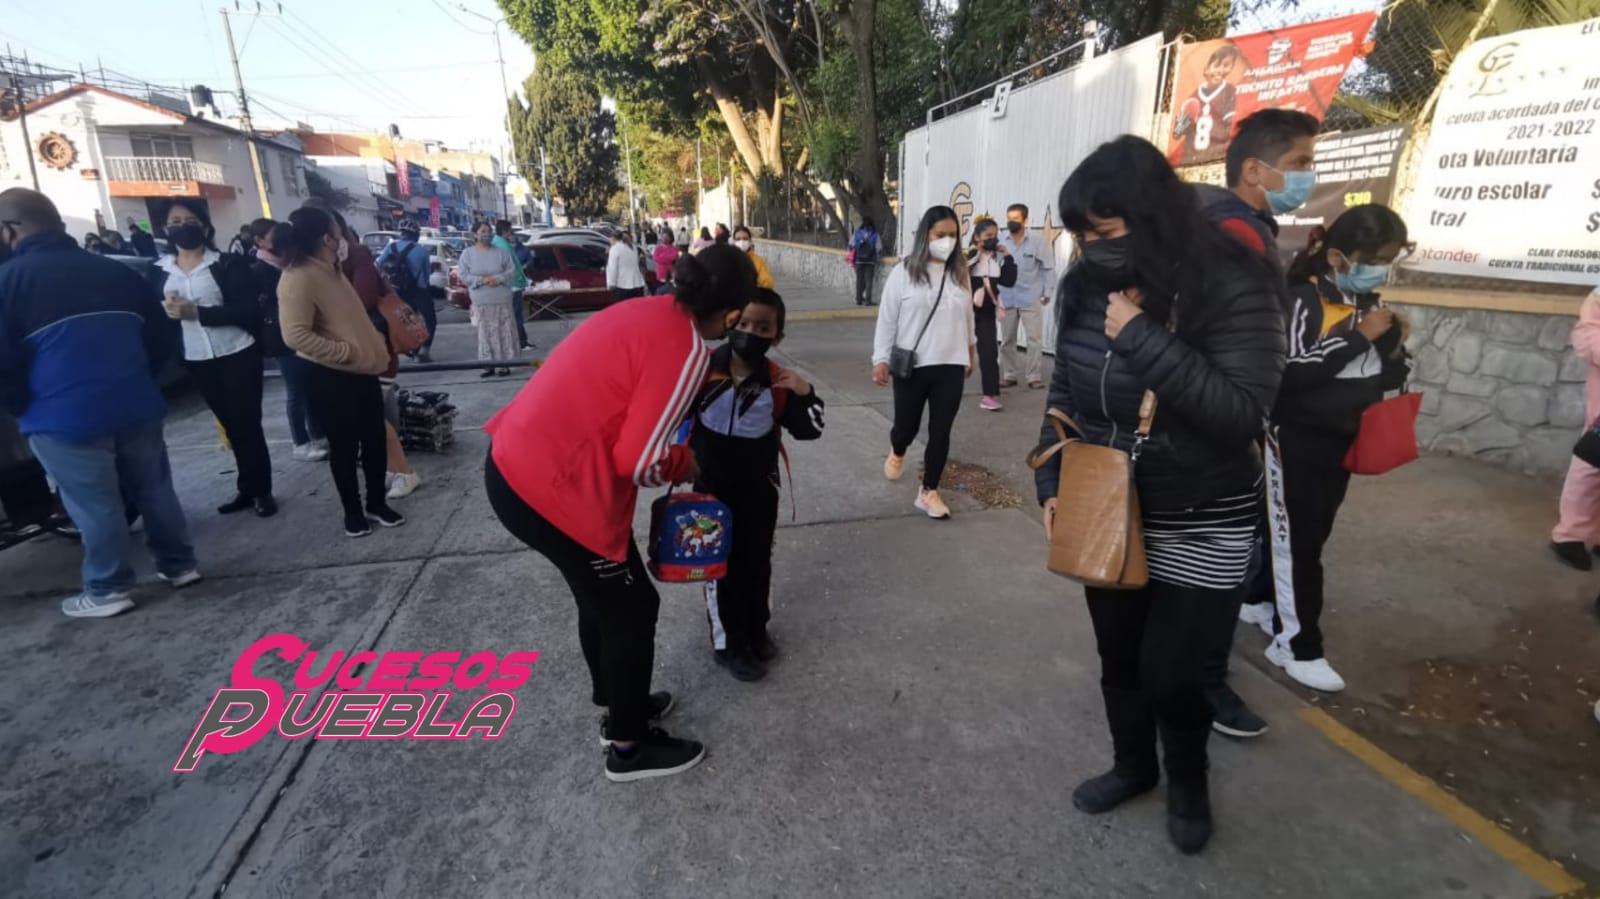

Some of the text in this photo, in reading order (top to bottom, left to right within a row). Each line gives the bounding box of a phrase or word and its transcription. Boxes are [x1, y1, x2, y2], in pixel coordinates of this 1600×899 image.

[1487, 102, 1559, 120] acordada
[1562, 98, 1590, 114] del
[1473, 145, 1579, 168] Voluntaria
[1477, 180, 1553, 200] escolar
[1430, 209, 1467, 227] tral
[1528, 247, 1555, 258] CLABE
[1488, 258, 1524, 270] CUENTA
[1525, 260, 1584, 274] TRADICIONAL
